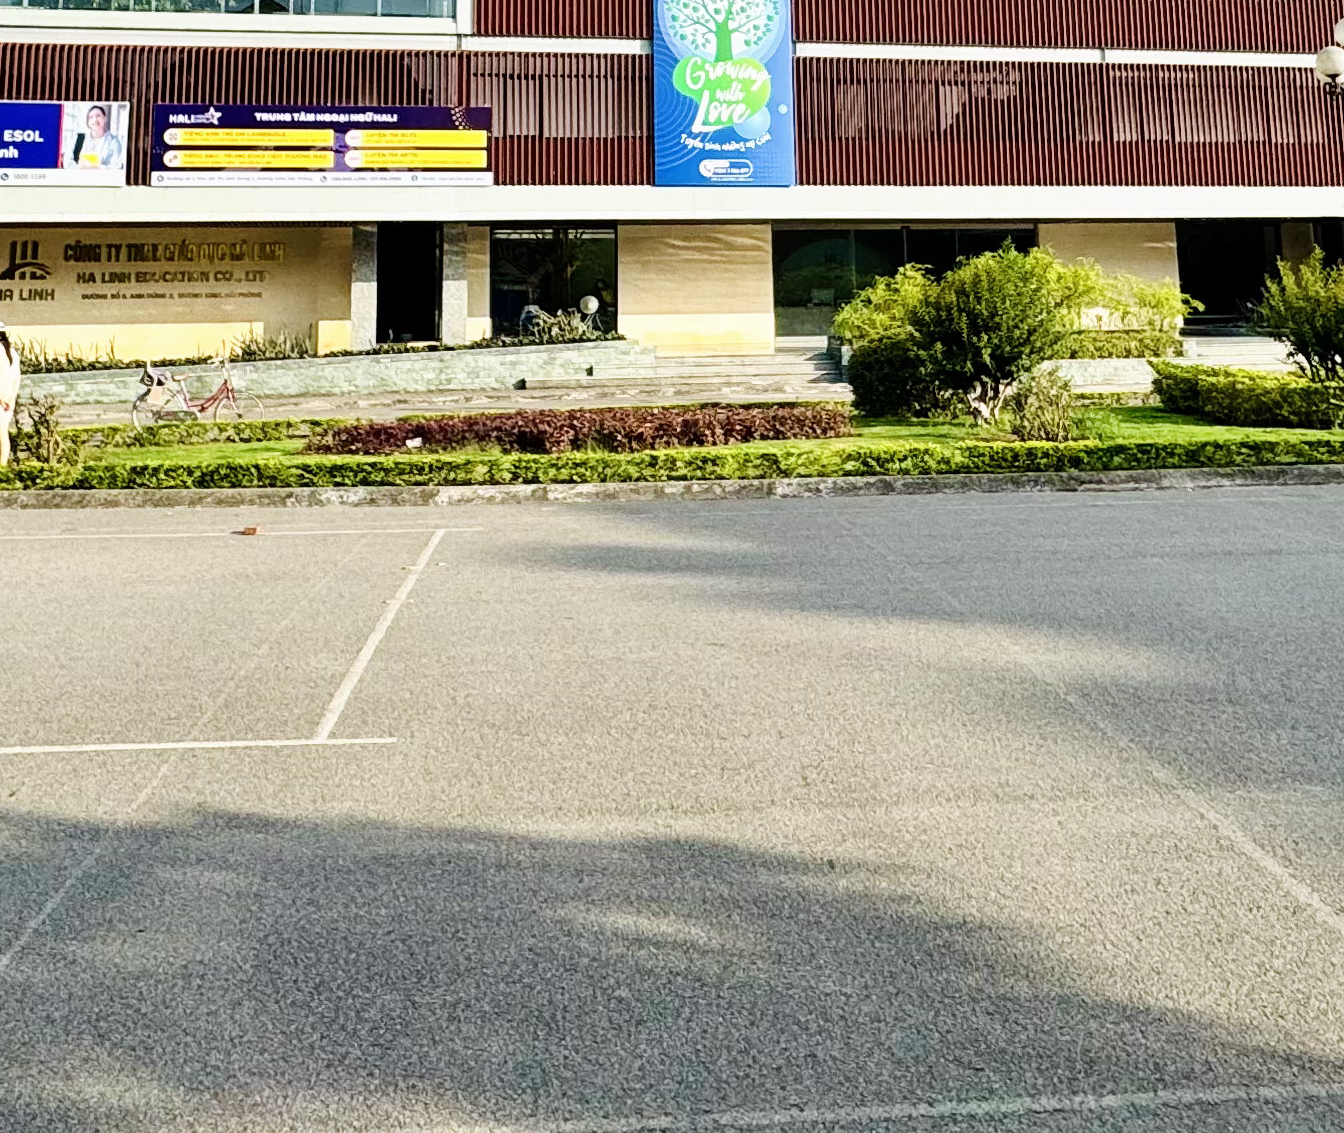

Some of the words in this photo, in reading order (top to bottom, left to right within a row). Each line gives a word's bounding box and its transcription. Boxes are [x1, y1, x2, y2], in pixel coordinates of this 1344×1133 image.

[685, 56, 771, 91] Growing
[715, 81, 746, 102] with
[254, 112, 292, 122] TRUNG
[293, 110, 315, 122] TÂM
[374, 113, 398, 123] HALI
[691, 90, 751, 133] Love
[3, 130, 44, 143] ESOL
[64, 239, 102, 263] CÔNG
[106, 242, 122, 262] TY
[77, 271, 97, 284] HA
[19, 289, 55, 301] LINH
